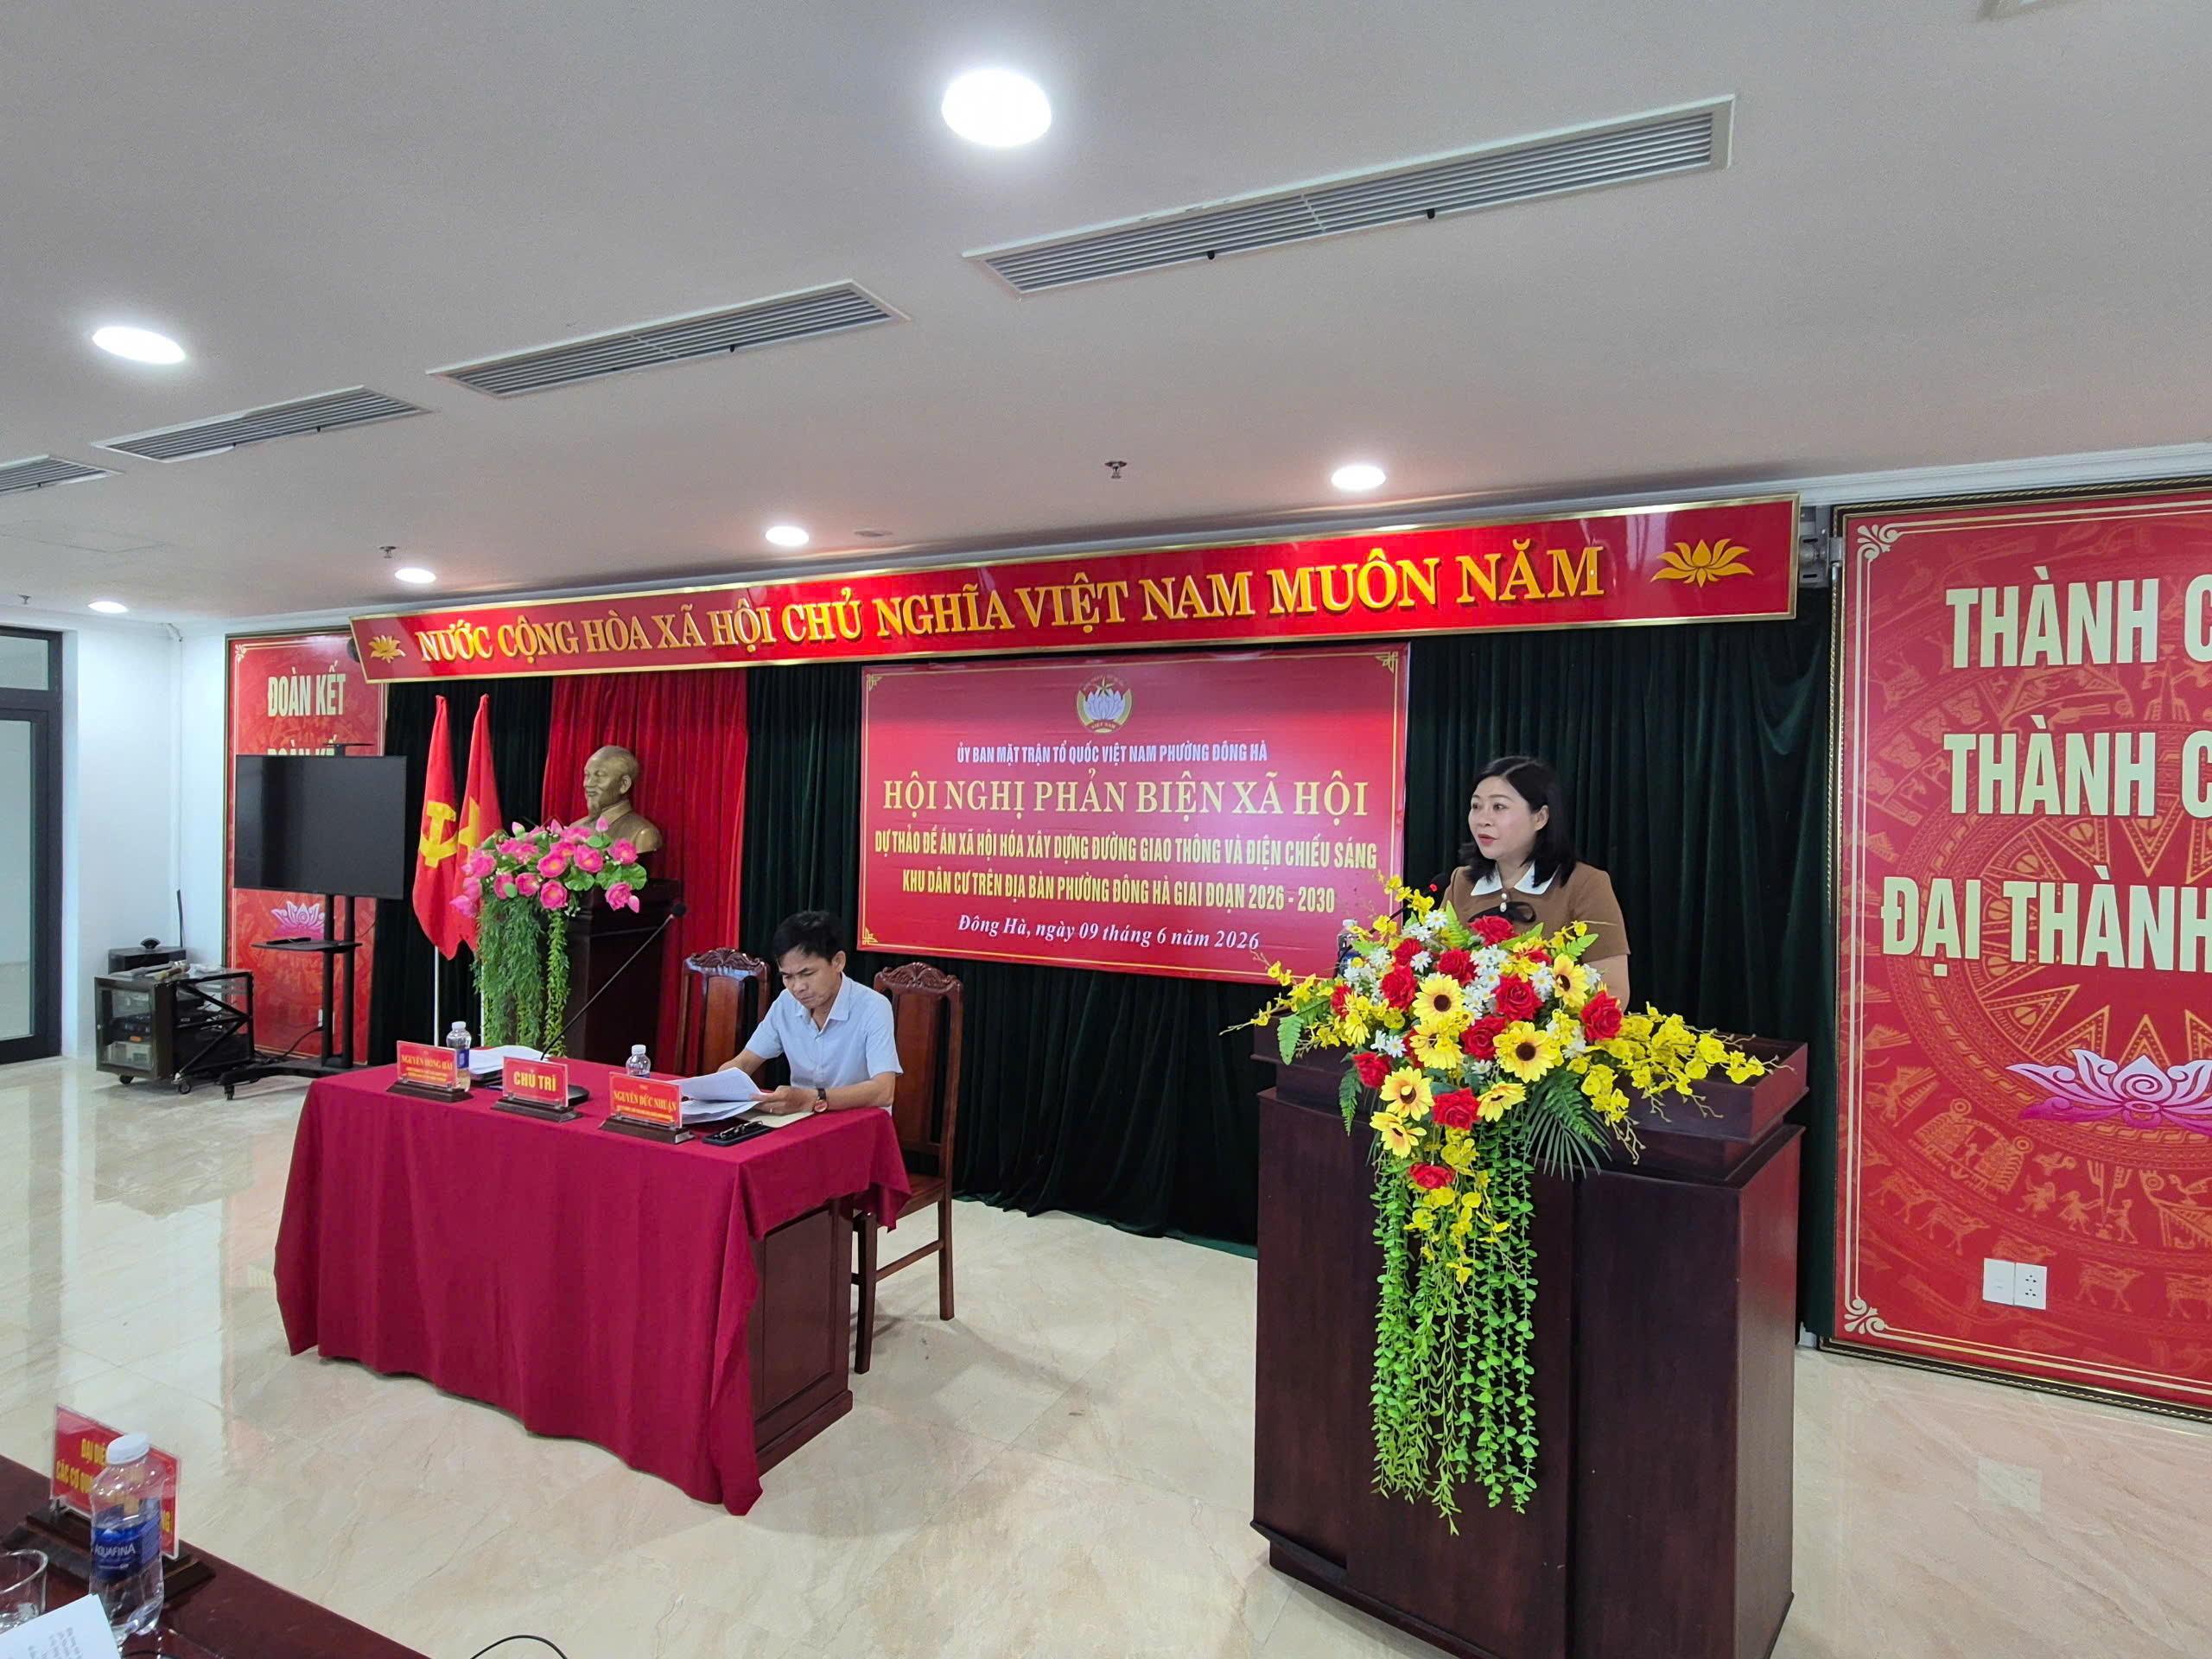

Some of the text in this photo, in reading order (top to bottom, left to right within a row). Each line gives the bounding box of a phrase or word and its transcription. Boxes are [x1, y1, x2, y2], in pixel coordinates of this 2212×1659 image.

[415, 538, 1605, 663] NƯỚC CỘNG HÒA XÃ HỘI CHỦ NGHĨA VIỆT NAM MUÔN NĂM
[1946, 565, 2159, 668] THÀNH
[268, 659, 346, 717] ĐOÀN KẾT
[957, 740, 1268, 766] ỦY BAN MẶT TRẬN TỔ QUỐC VIỆT NAM PHƯỜNG ĐÔNG HÀ
[1943, 715, 2156, 817] THÀNH
[883, 768, 1369, 826] HỘI NGHỊ PHẢN BIỆN XÃ HỘI
[875, 829, 891, 857] DỰ
[893, 823, 920, 854] THẢO
[940, 827, 956, 855] ÁN
[958, 829, 974, 855] XÃ
[977, 829, 996, 861] HỘI
[1000, 830, 1024, 857] HÓA
[1027, 830, 1051, 858] XÂY
[1054, 833, 1089, 864] DỰNG
[1091, 830, 1136, 861] ĐƯỜNG
[1140, 837, 1172, 862] GIAO
[1175, 833, 1221, 863] THÔNG
[1224, 834, 1243, 864] VÀ
[1246, 835, 1281, 871] ĐIỆN
[1285, 833, 1330, 868] CHIẾU
[1334, 836, 1377, 869] SÁNG
[903, 869, 925, 892] KHU
[928, 866, 950, 893] DÂN
[954, 869, 971, 894] CƯ
[972, 868, 1002, 896] TRÊN
[1005, 874, 1026, 903] ĐỊA
[1028, 870, 1054, 899] BÀN
[1058, 872, 1109, 902] PHƯỜNG
[1113, 874, 1149, 904] ĐÔNG
[1153, 875, 1170, 905] HÀ
[1174, 880, 1202, 906] GIAI
[1206, 882, 1245, 913] ĐOẠN
[1249, 884, 1285, 910] 2026
[1298, 887, 1335, 912] 2030
[958, 914, 1260, 950] Đông Hà, ngày 09 tháng 6 năm 2026
[1881, 865, 2212, 976] ĐẠI THÀNH
[513, 1069, 536, 1088] CHỦ
